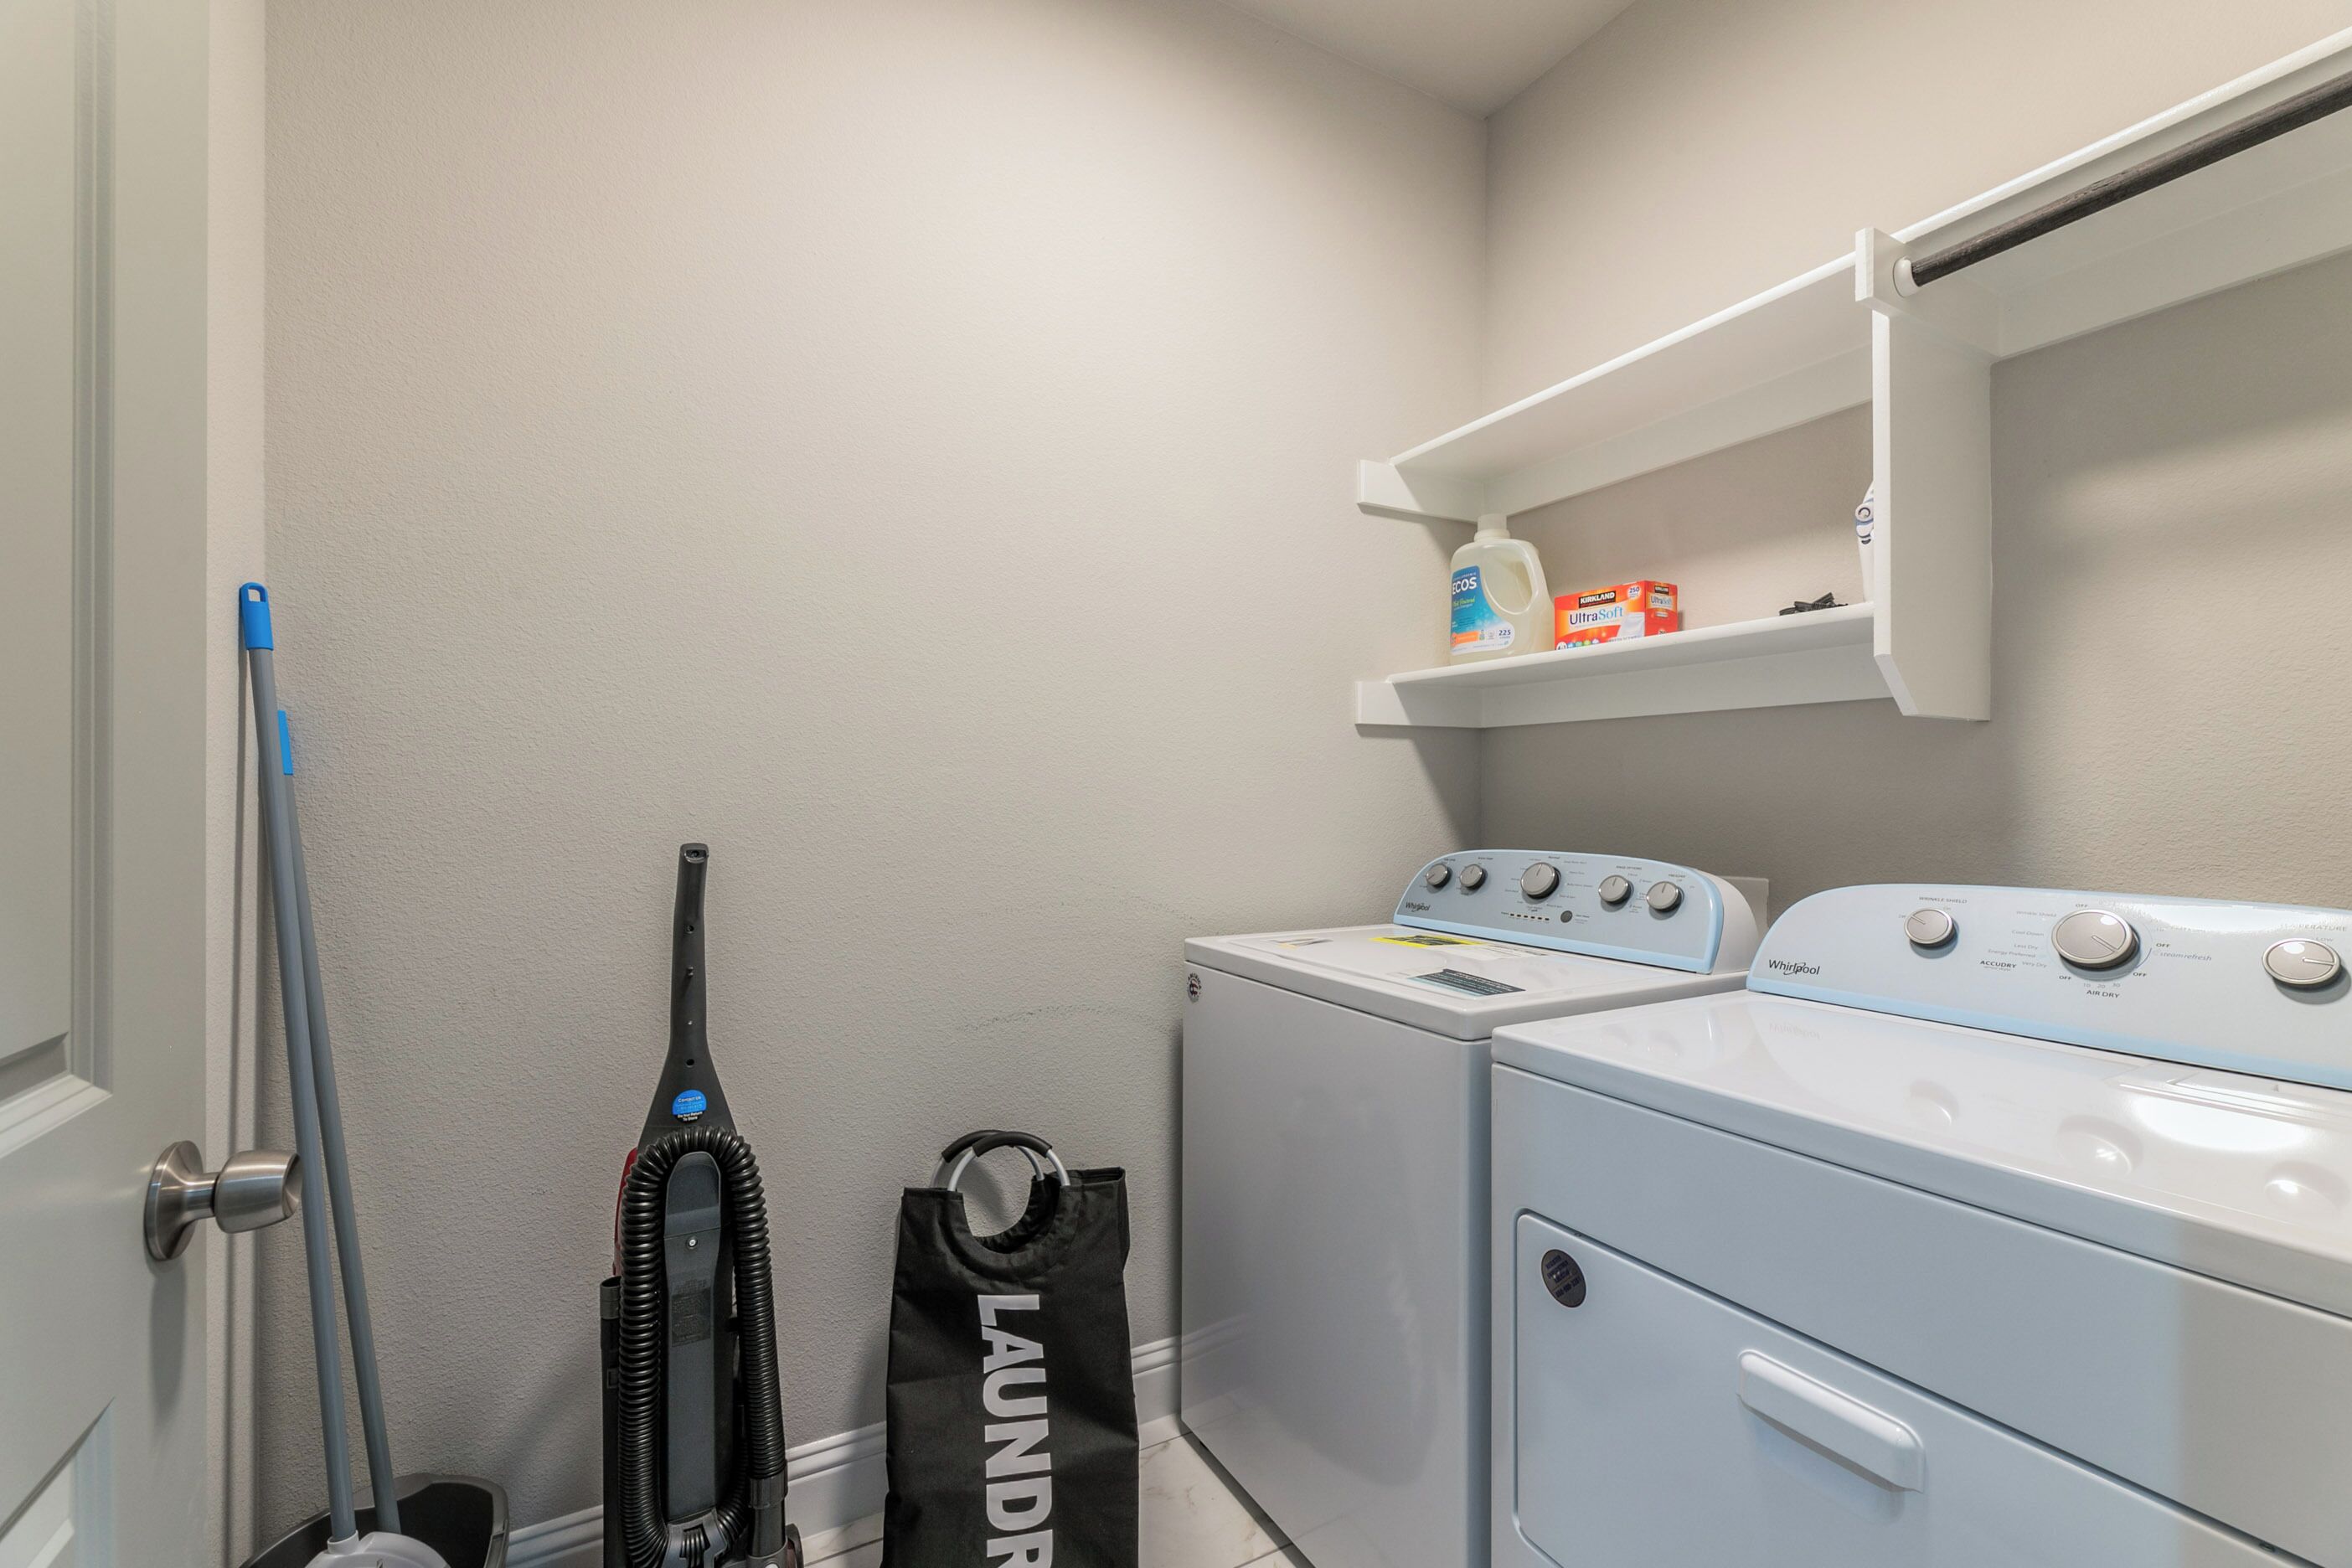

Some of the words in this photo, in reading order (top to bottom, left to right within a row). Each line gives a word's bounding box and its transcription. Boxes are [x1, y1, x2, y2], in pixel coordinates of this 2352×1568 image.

[1452, 576, 1478, 595] ECOS
[1580, 591, 1615, 604] KIRKLAND
[1570, 606, 1623, 625] UltraSoft
[1406, 901, 1431, 912] Whirlpool
[1768, 958, 1821, 976] Whirlpool
[1980, 960, 2017, 969] ACCUDRY
